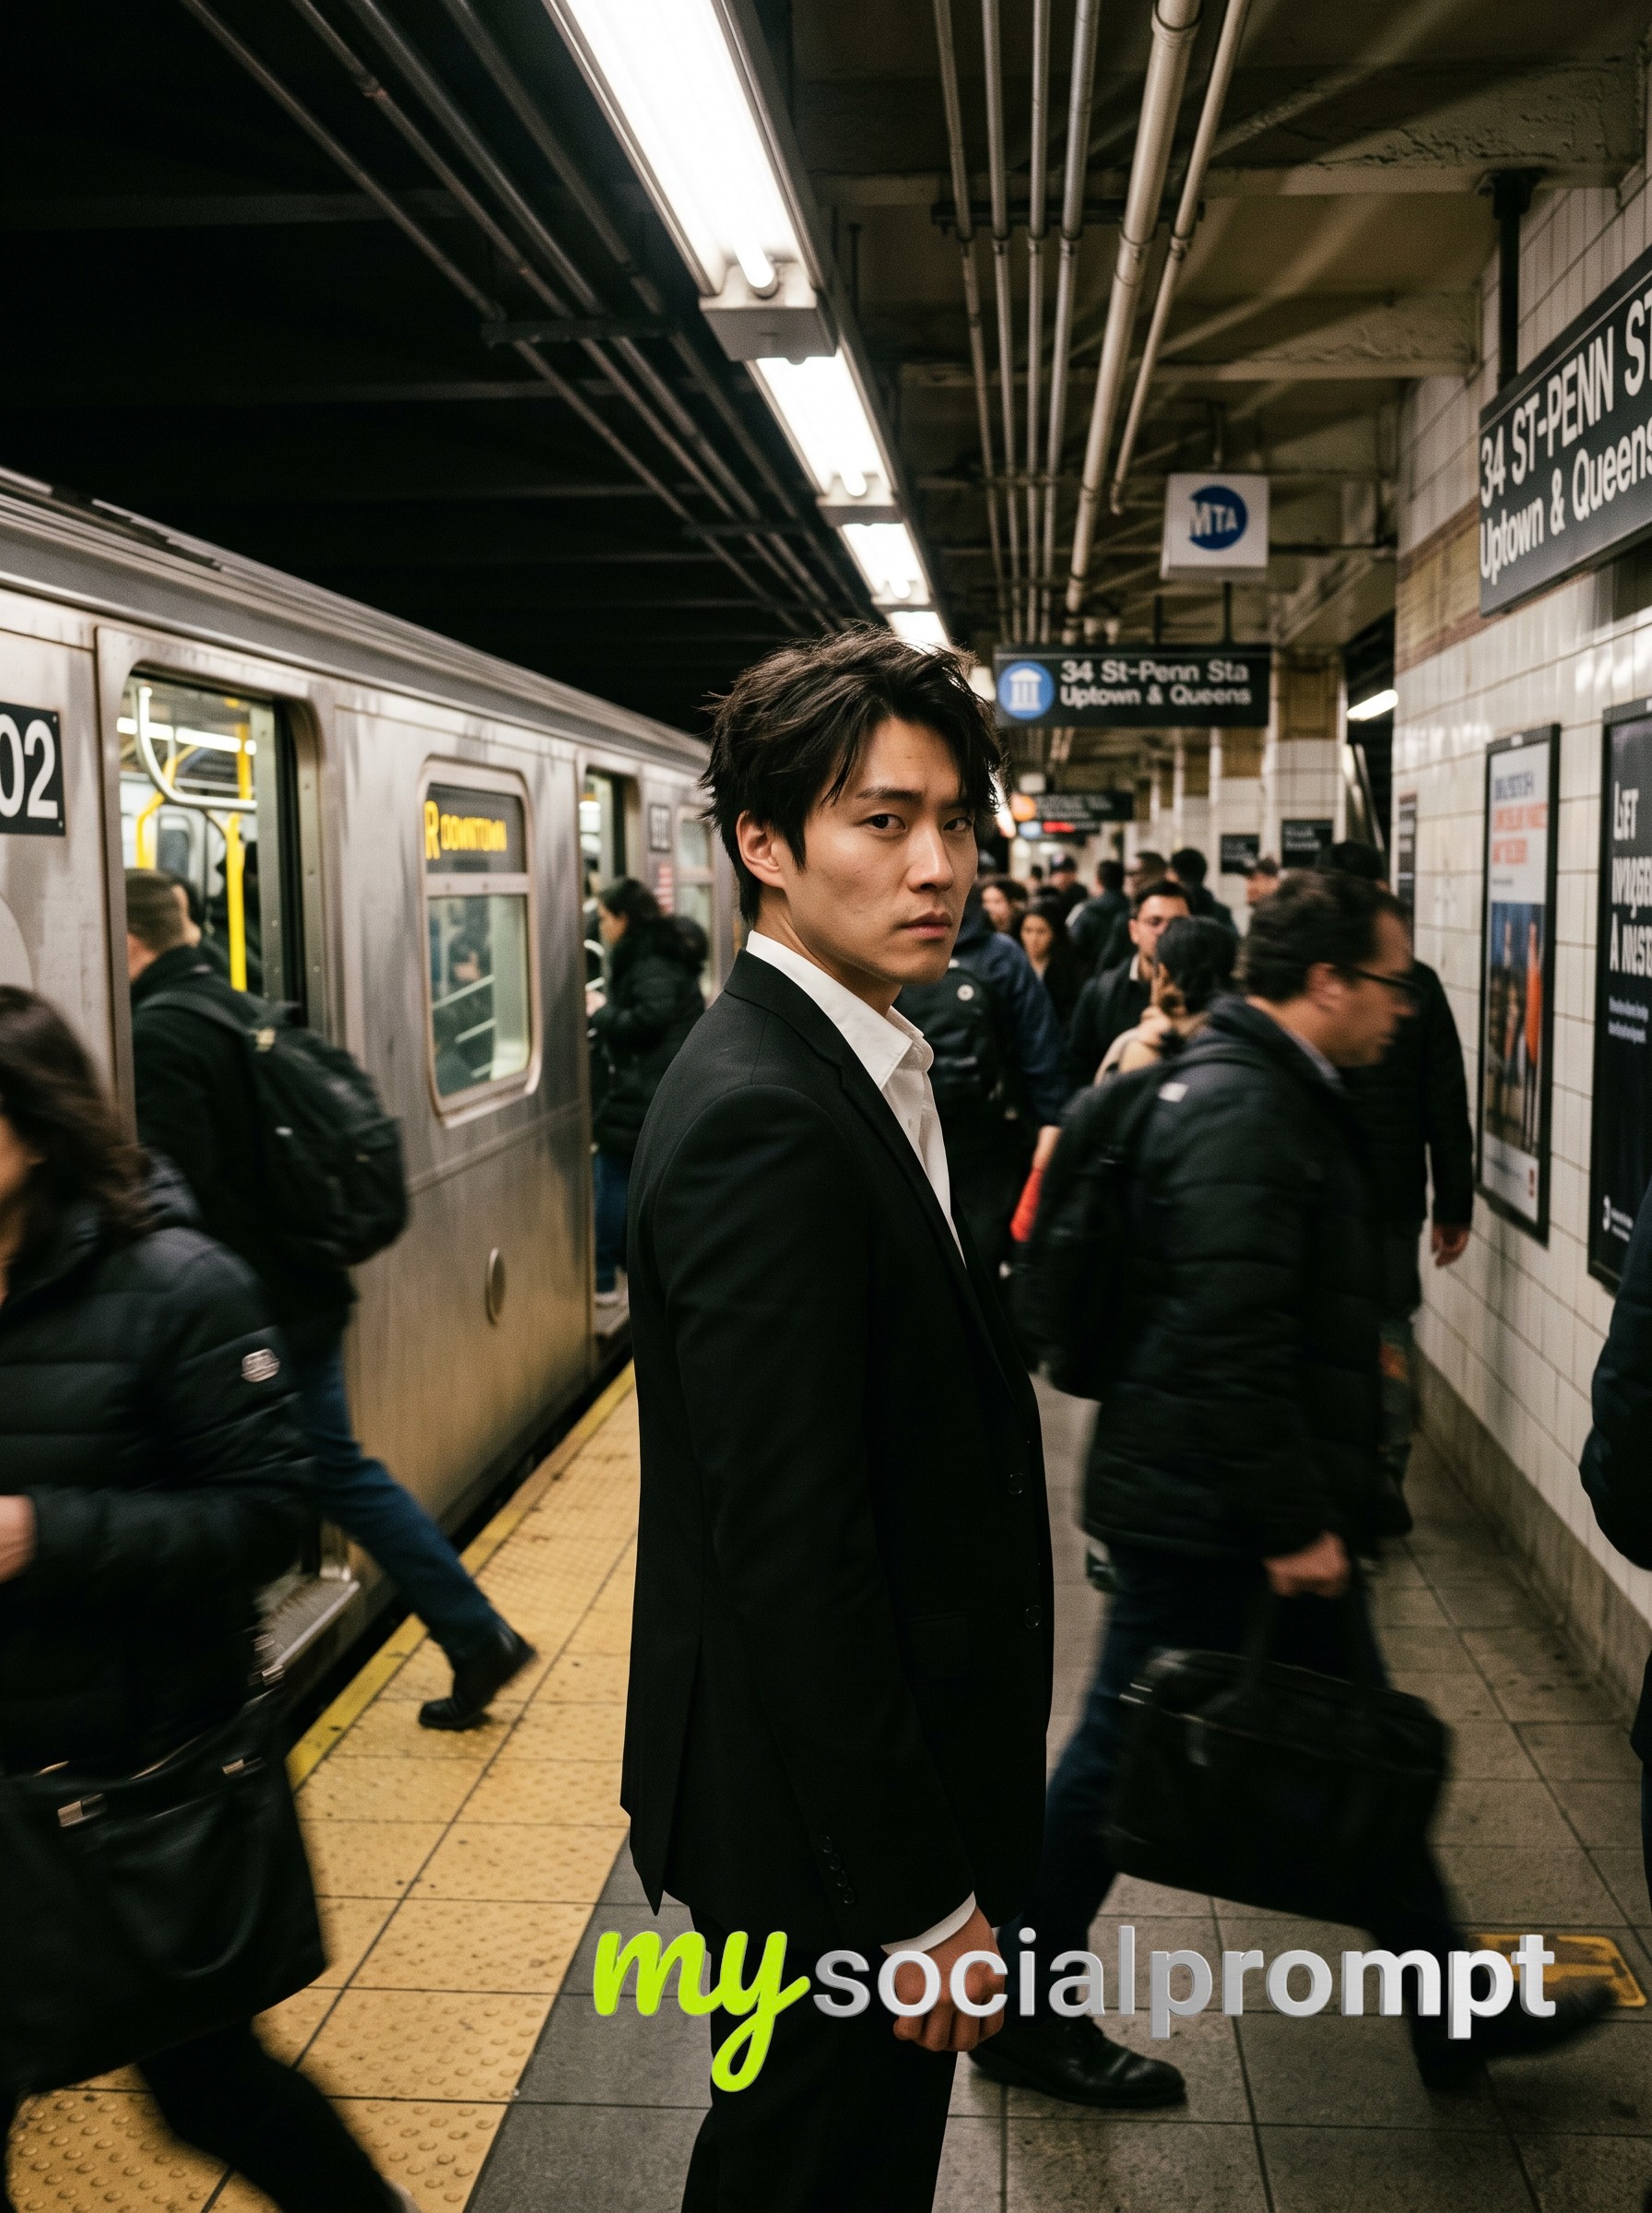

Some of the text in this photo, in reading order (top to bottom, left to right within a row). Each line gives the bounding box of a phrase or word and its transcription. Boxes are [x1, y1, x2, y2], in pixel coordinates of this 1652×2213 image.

[1481, 425, 1506, 507] 34
[1512, 325, 1614, 486] ST-PENN
[1190, 501, 1238, 537] MTA
[1480, 497, 1544, 586] Uptown
[1550, 467, 1566, 537] &
[1060, 658, 1249, 683] 34 St-Penn Sta
[1060, 683, 1252, 710] Uptown & Queens
[425, 800, 440, 859] R
